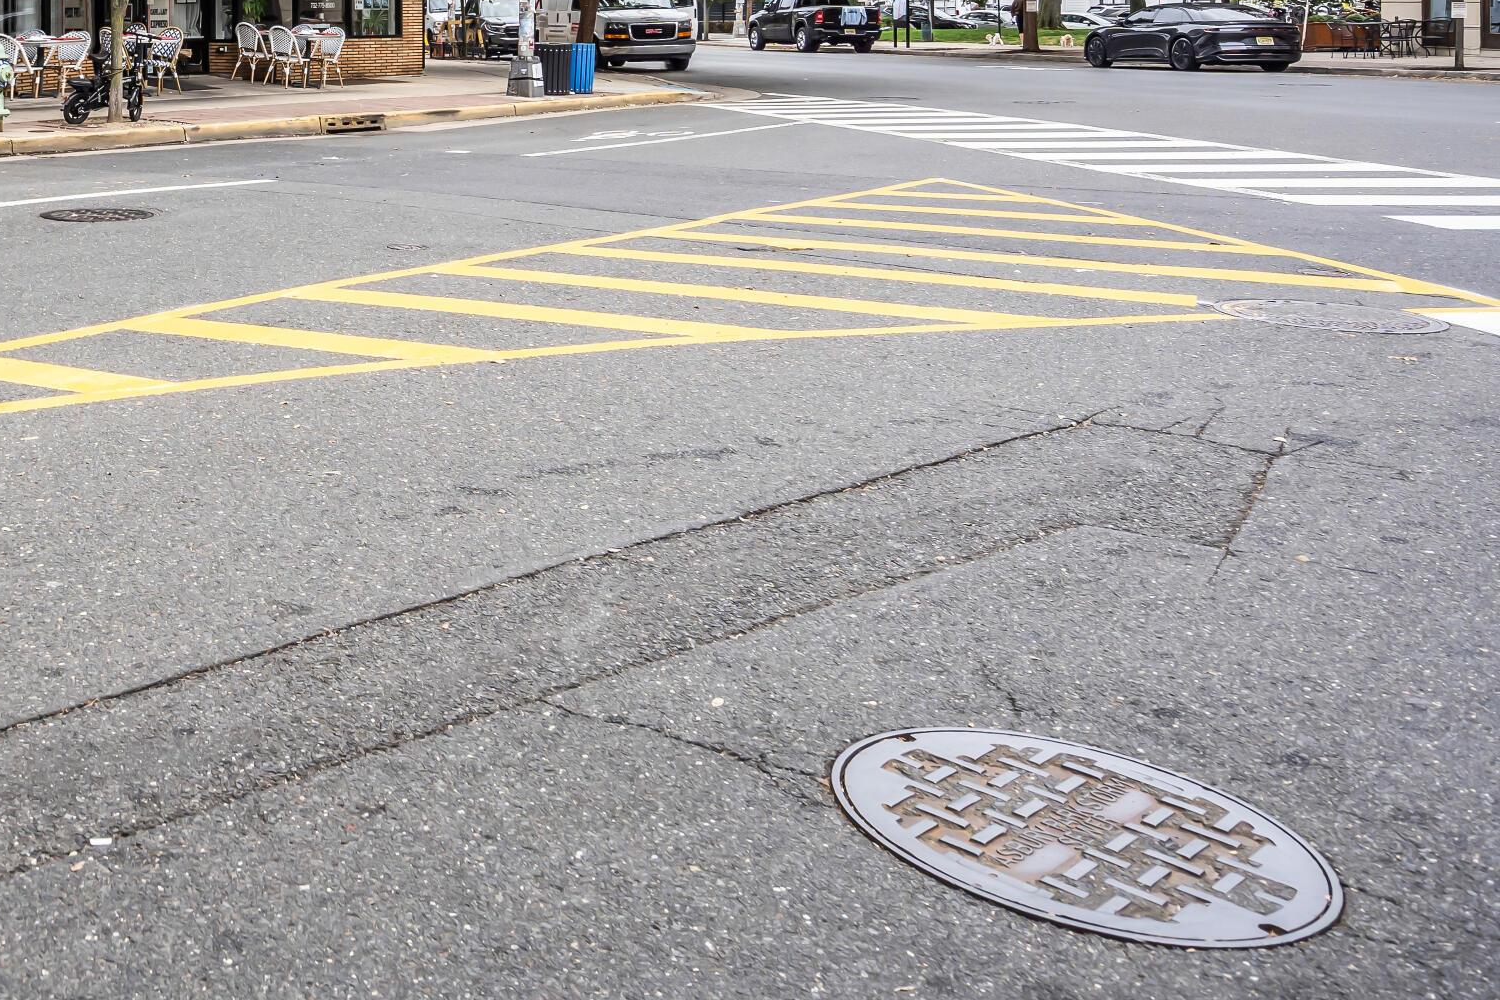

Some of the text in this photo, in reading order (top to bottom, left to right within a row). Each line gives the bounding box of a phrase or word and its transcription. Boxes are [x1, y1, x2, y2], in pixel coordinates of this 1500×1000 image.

[991, 776, 1135, 869] ASBURY PARK STORM
[1056, 814, 1125, 852] SEWER
